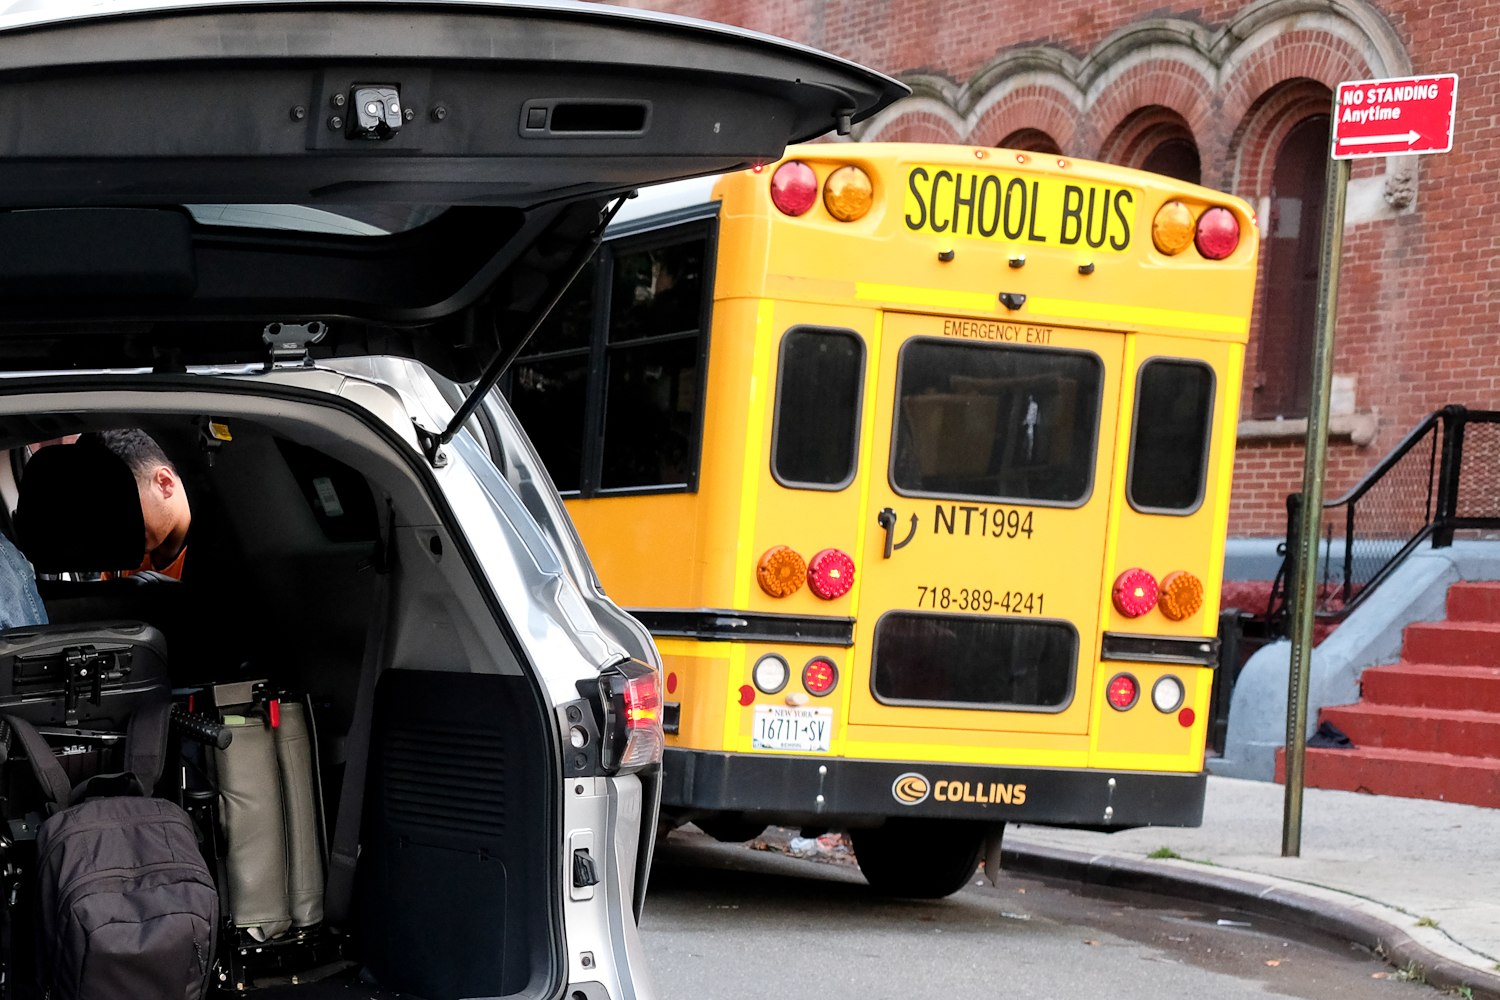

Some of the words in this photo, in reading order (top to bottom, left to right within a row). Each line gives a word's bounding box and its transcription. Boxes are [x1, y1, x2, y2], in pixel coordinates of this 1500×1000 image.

[1343, 90, 1364, 106] NO
[1367, 84, 1438, 103] STANDING
[1342, 105, 1401, 124] Anytime
[905, 167, 1046, 243] SCHOOL
[1060, 185, 1133, 251] BUS
[943, 320, 1021, 341] EMERGENCY
[1026, 327, 1053, 344] EXIT
[934, 505, 1033, 539] NT1994
[917, 586, 1044, 614] 718-389-4241
[775, 709, 791, 717] NEW
[794, 710, 813, 718] YORK
[934, 780, 1027, 805] COLLINS
